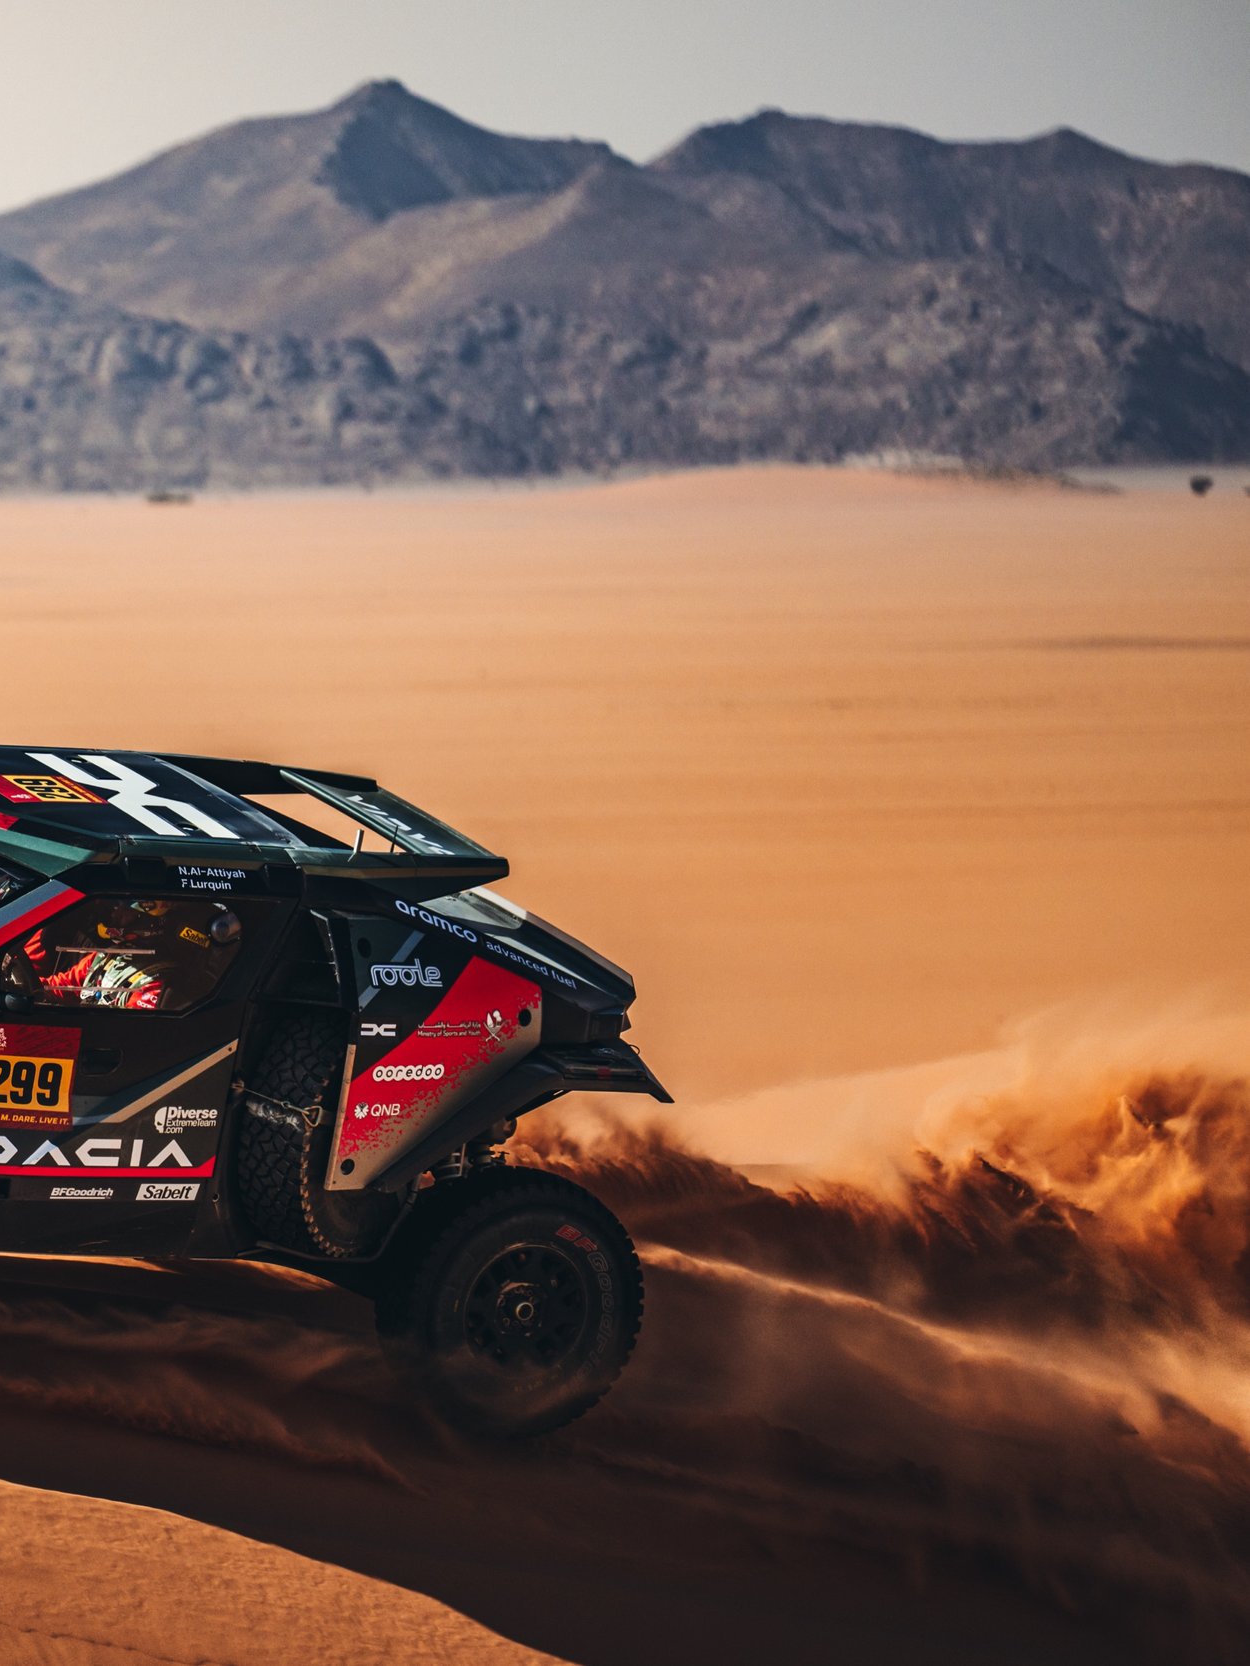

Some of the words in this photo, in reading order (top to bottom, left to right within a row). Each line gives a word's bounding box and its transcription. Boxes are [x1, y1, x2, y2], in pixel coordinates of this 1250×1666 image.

[13, 778, 82, 800] 299
[178, 866, 246, 879] N.Al-Attiyah
[394, 899, 478, 943] aramco
[485, 941, 549, 977] advanced
[551, 969, 578, 990] fuel
[371, 958, 443, 987] roole
[374, 1064, 443, 1080] ooredoo
[168, 1106, 218, 1119] Diverse
[371, 1104, 400, 1117] QNB
[12, 1115, 37, 1124] DARE.
[39, 1116, 58, 1125] LIVE
[166, 1119, 217, 1127] ExtremeTeam
[50, 1187, 114, 1196] BFGoodrich
[143, 1184, 192, 1199] Sabelt
